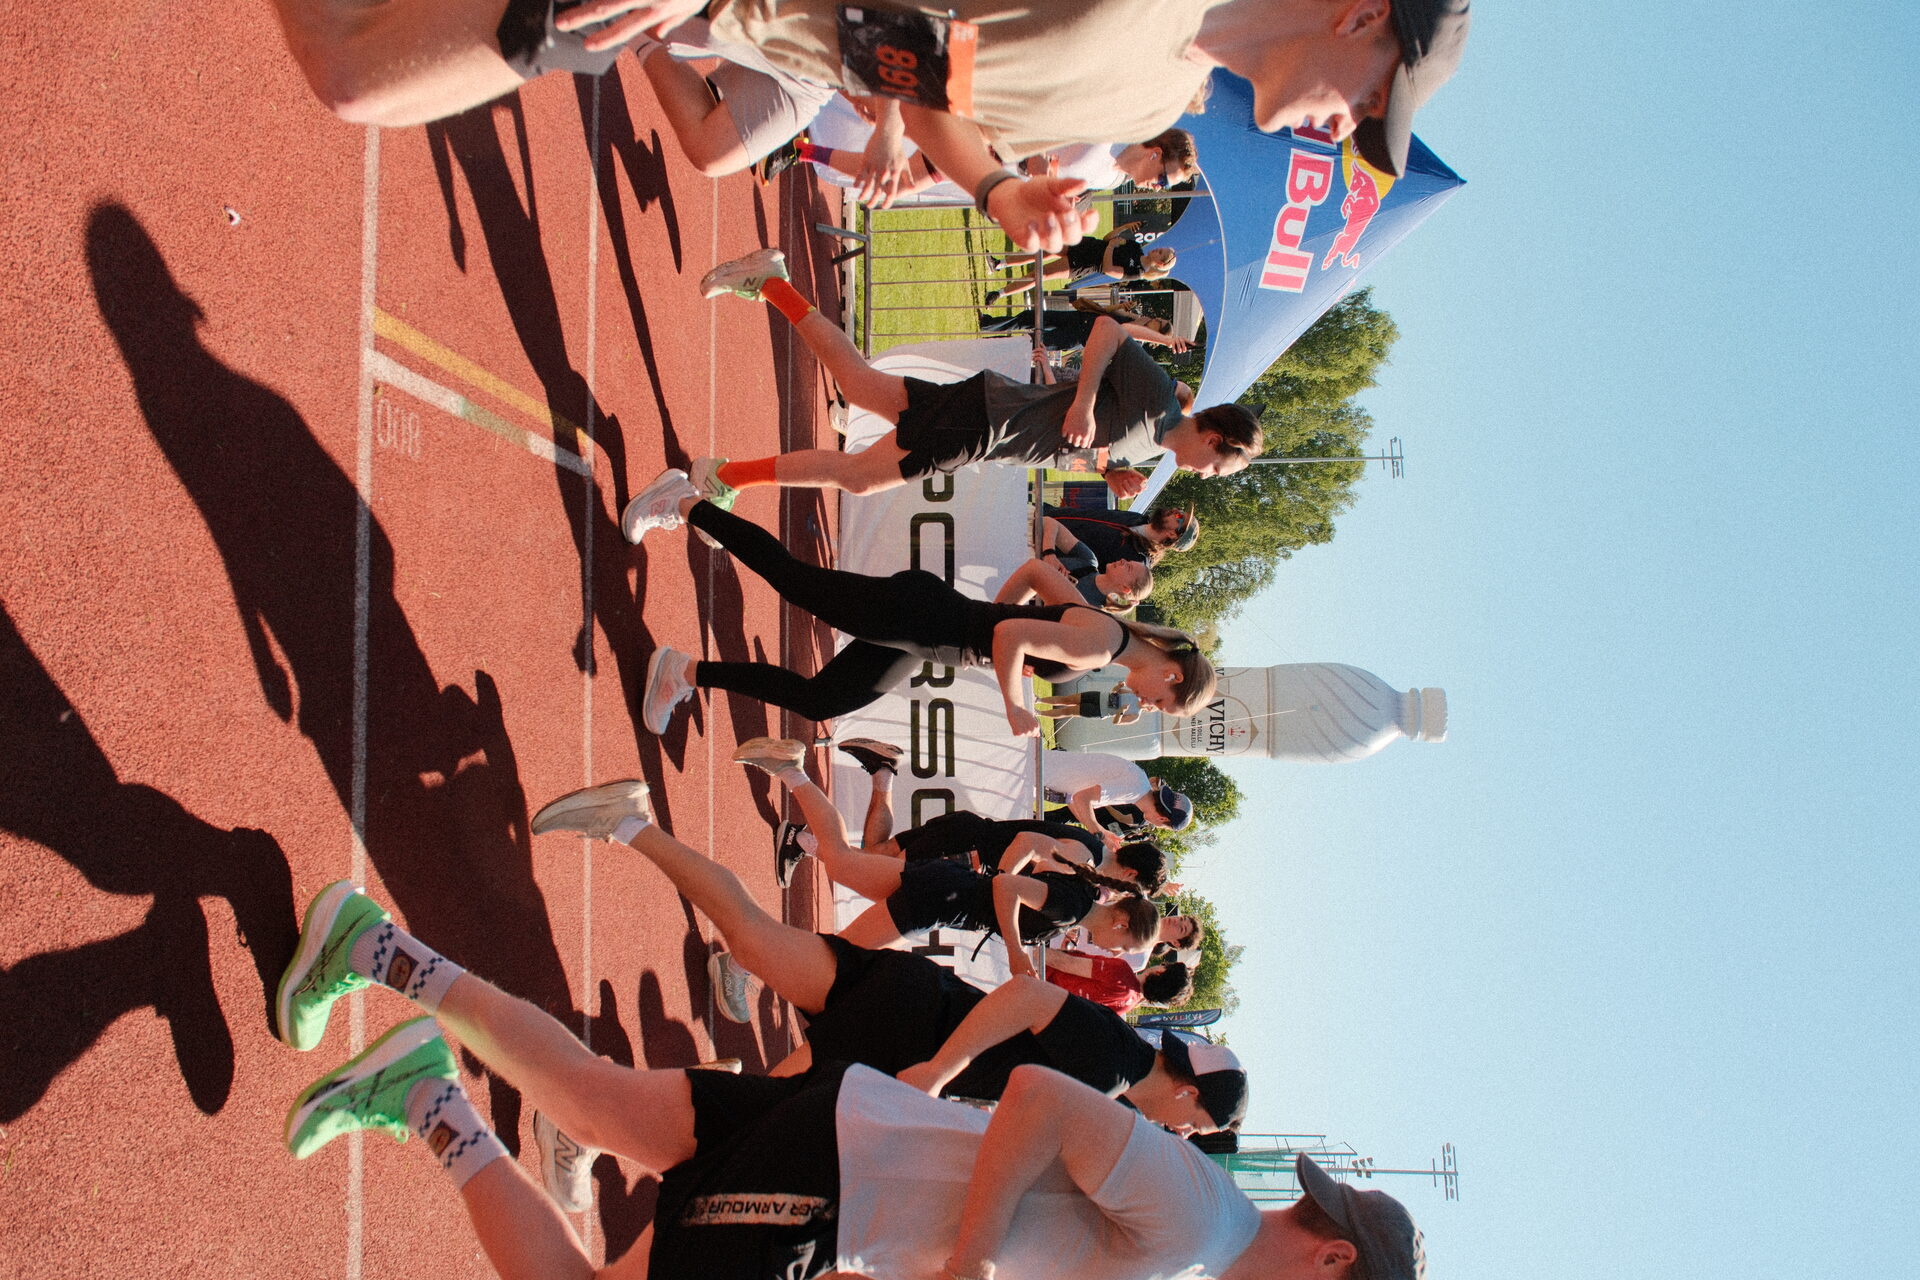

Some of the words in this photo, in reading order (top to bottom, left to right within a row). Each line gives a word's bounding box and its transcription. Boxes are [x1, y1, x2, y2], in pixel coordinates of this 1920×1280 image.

[875, 45, 919, 97] 891
[1258, 148, 1334, 293] Bull
[1206, 699, 1225, 754] VICHY
[786, 826, 796, 846] HOKA
[724, 972, 732, 996] HOKA
[555, 1130, 580, 1172] N
[708, 1201, 786, 1216] ARMOUR
